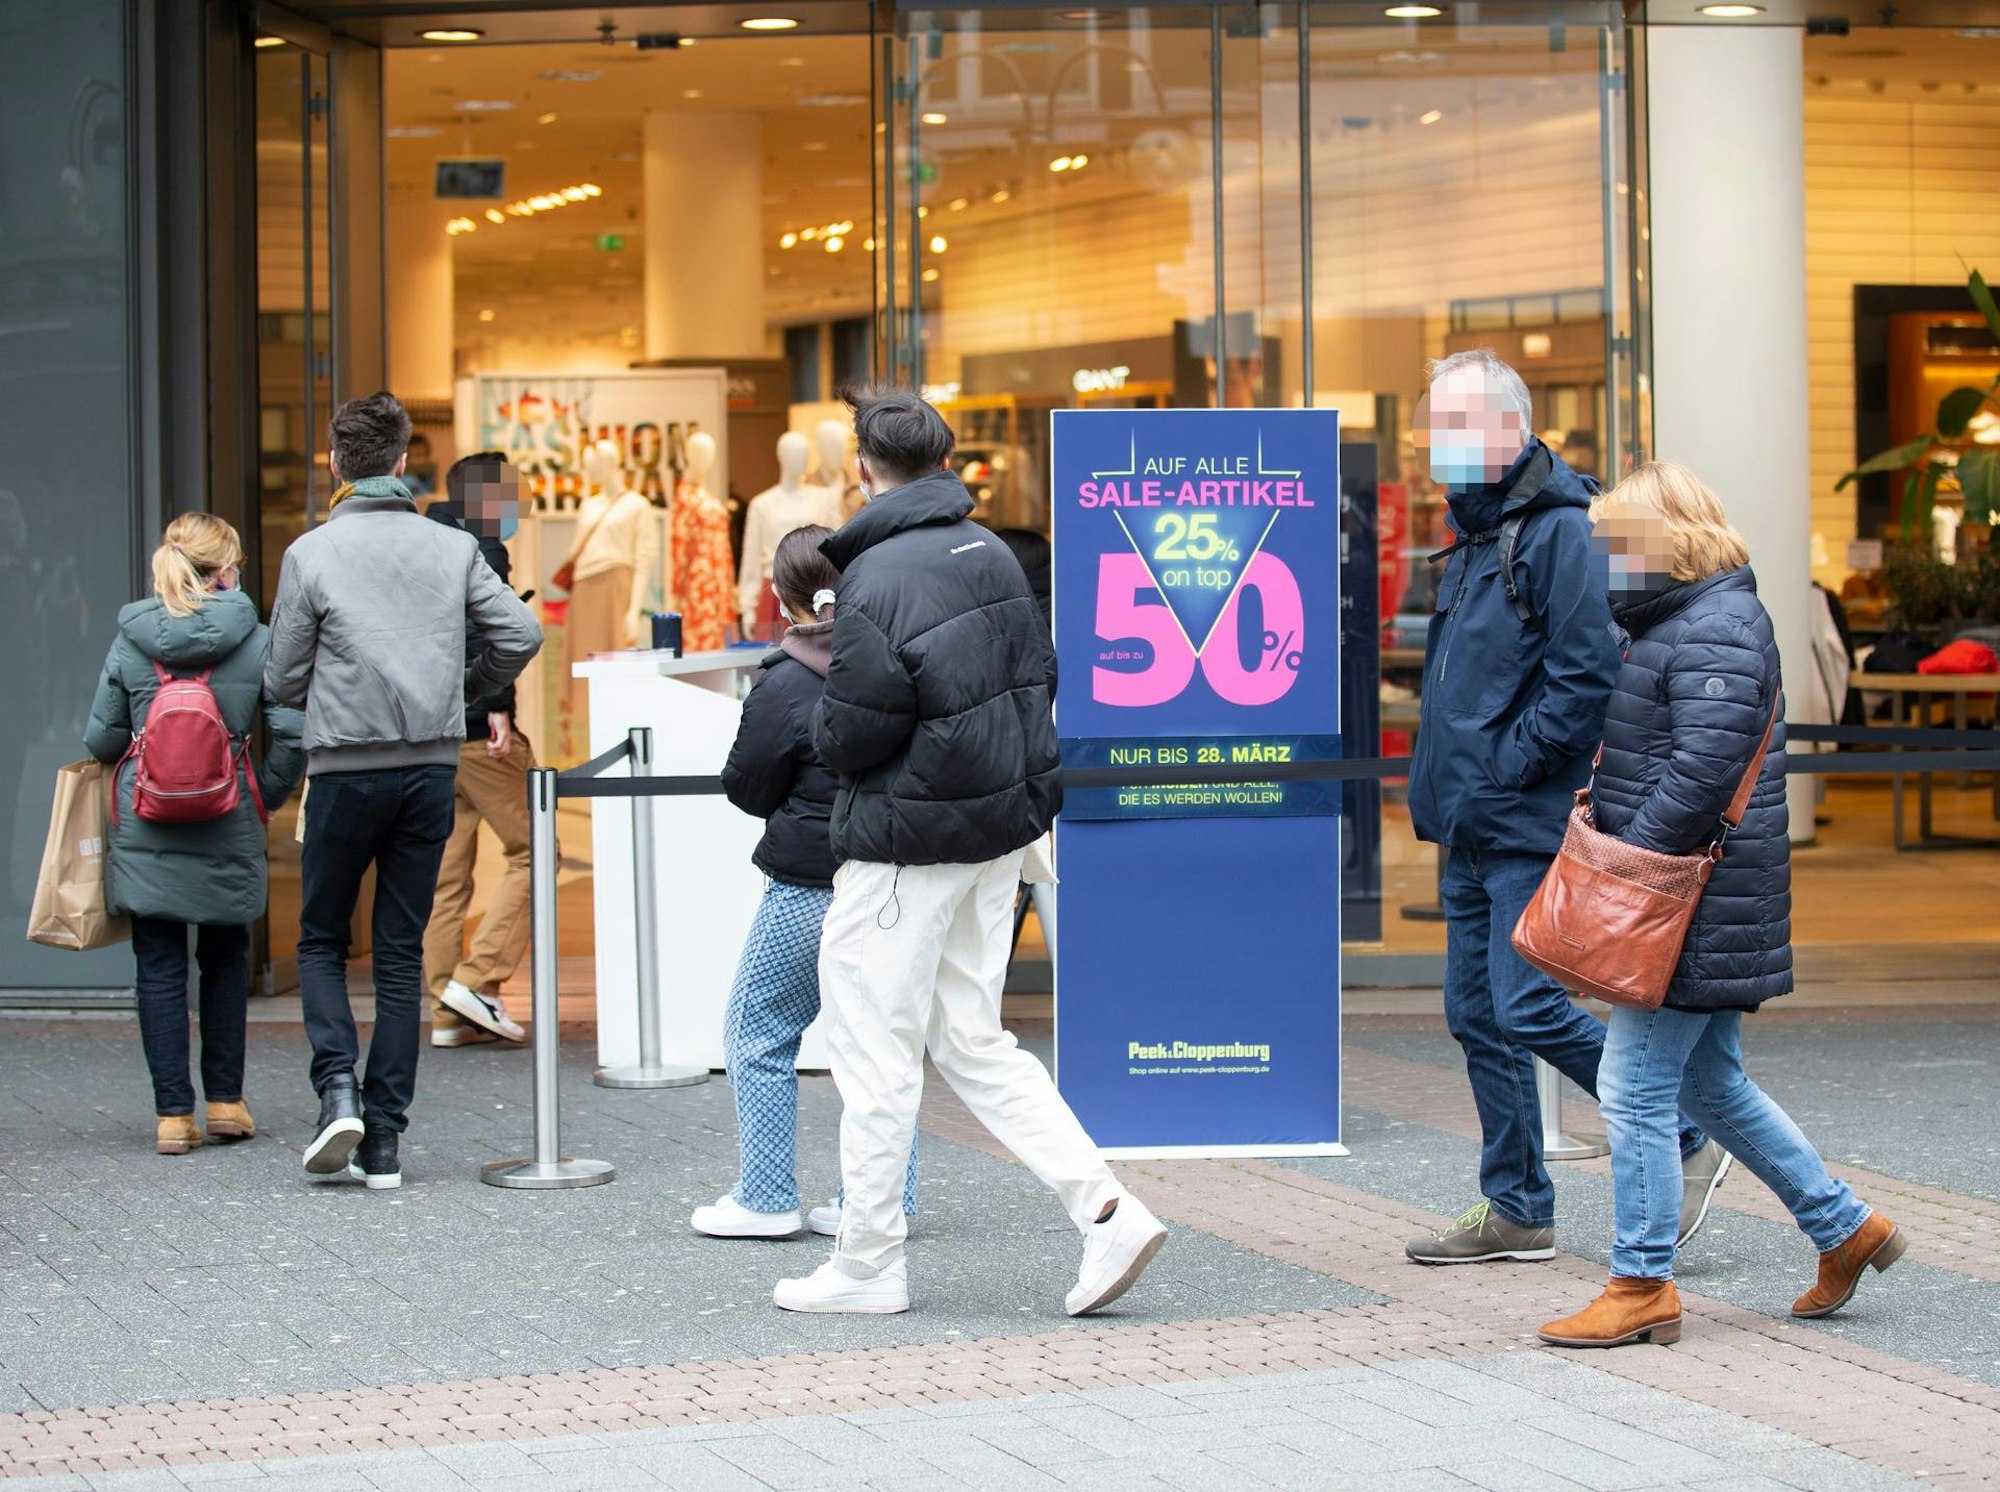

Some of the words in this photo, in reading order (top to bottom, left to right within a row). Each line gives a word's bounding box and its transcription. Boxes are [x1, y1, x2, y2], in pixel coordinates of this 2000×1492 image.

[1144, 458, 1187, 474] AUF
[1195, 457, 1249, 474] ALLE
[1079, 481, 1315, 508] SALE-ARTIKEL
[1153, 514, 1240, 561] 25%
[1163, 570, 1190, 586] on
[1197, 567, 1232, 590] top
[1100, 651, 1114, 660] auf
[1117, 650, 1131, 660] bis
[1133, 652, 1144, 660] zu
[1110, 748, 1151, 764] NUR
[1157, 748, 1188, 764] BIS
[1197, 747, 1226, 763] 28.
[1232, 743, 1291, 763] MÄRZ
[1119, 794, 1139, 806] DIE
[1143, 794, 1160, 805] ES
[1164, 793, 1221, 805] WERDEN
[1224, 792, 1282, 803] WOLLEN!
[1129, 1067, 1147, 1075] Shop
[1181, 1065, 1270, 1074] www.peek-cloppenburg.de
